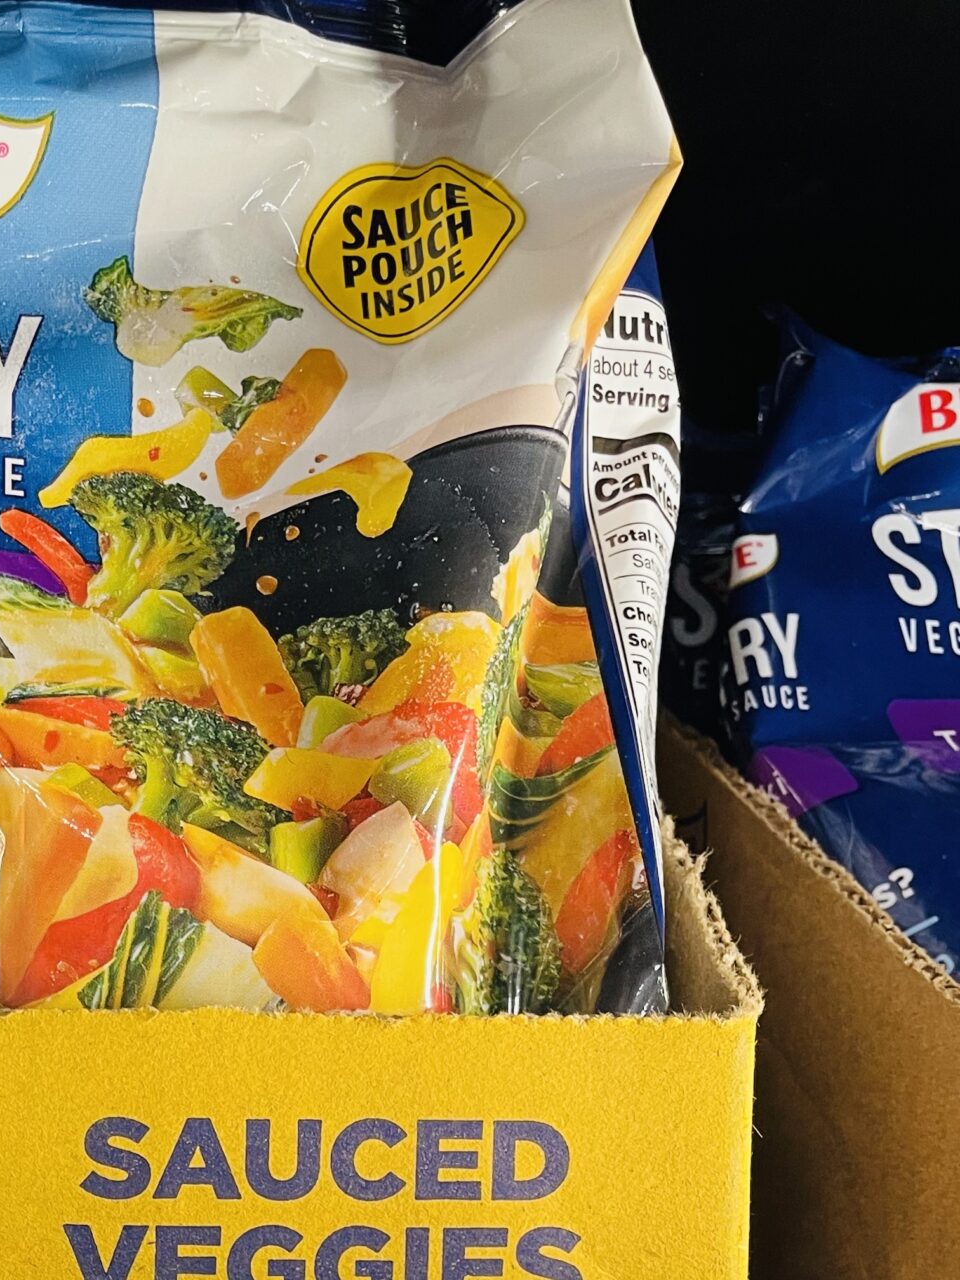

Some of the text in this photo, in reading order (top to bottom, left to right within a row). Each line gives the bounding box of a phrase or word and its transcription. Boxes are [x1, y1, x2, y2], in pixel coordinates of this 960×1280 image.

[341, 181, 469, 251] SAUCE
[342, 209, 473, 289] POUCH
[359, 249, 466, 320] INSIDE
[593, 355, 639, 378] about
[643, 360, 654, 379] 4
[592, 383, 671, 414] Serving
[593, 450, 649, 473] Amount
[595, 463, 679, 518] Calries
[606, 529, 652, 548] Total
[80, 1116, 570, 1206] SAUCED
